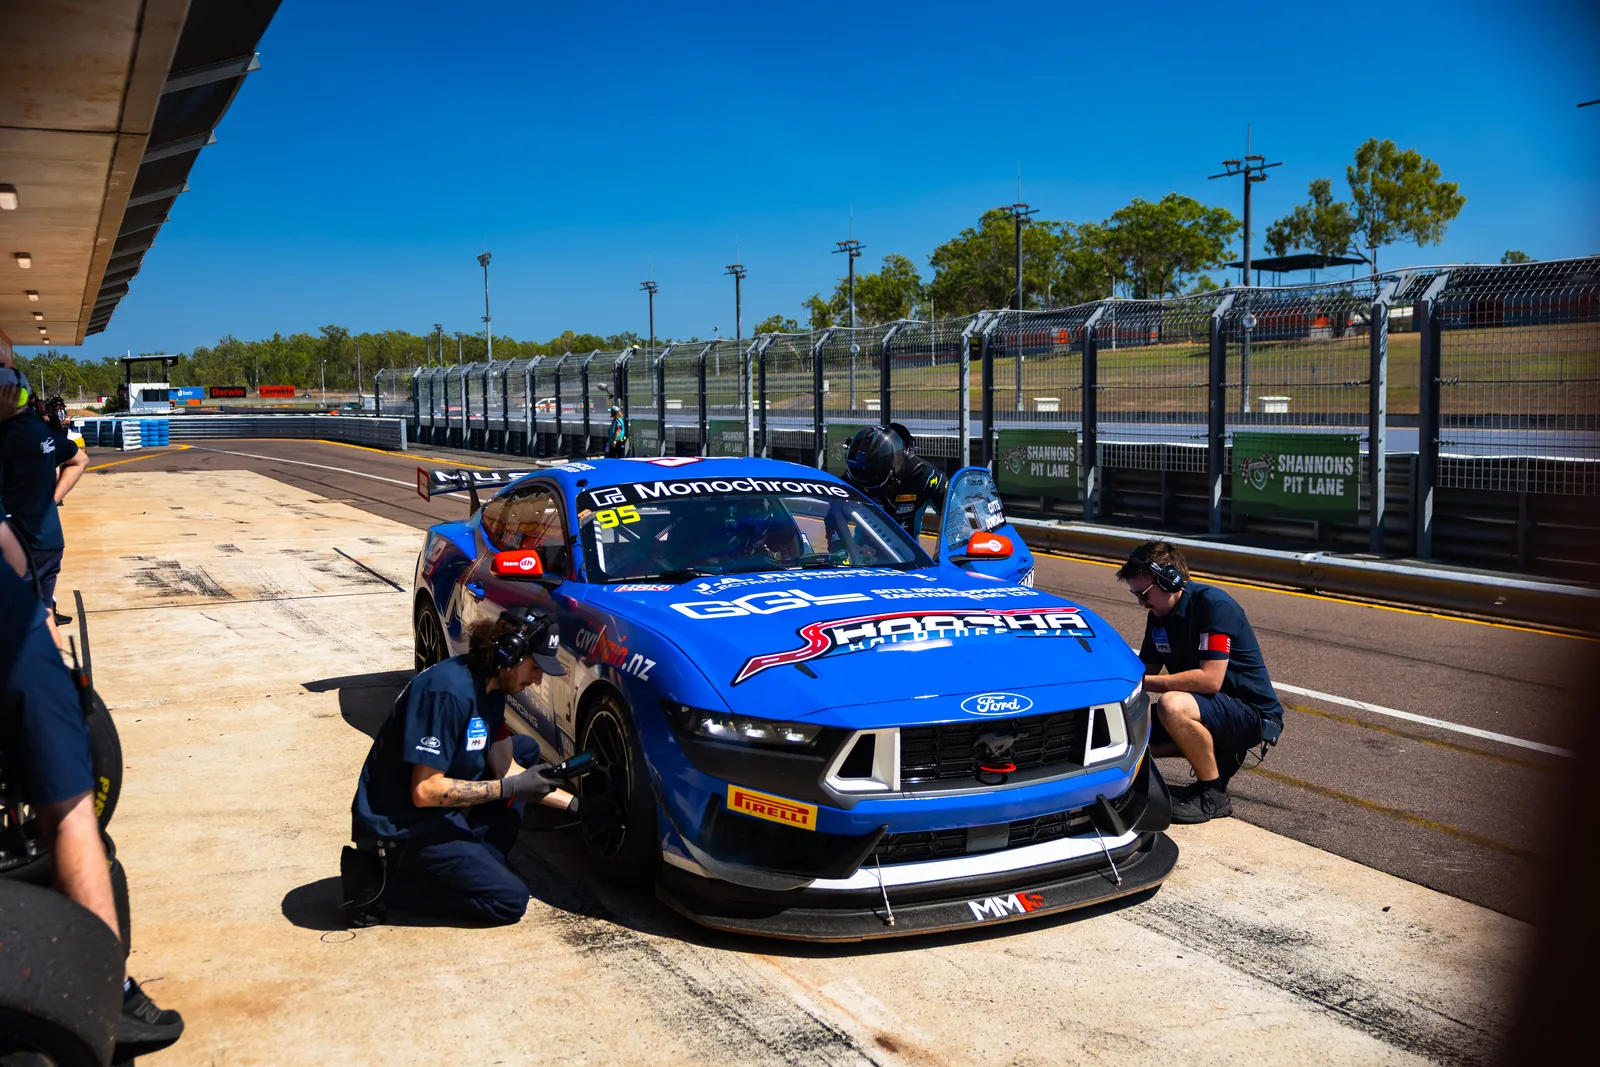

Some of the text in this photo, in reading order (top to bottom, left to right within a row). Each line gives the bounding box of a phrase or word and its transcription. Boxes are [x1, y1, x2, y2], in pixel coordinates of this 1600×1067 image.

[212, 388, 244, 397] Darwin
[1027, 445, 1075, 462] SHANNONS
[1030, 462, 1070, 478] PIT LANE
[1278, 454, 1354, 476] SHANNONS
[633, 477, 850, 499] Monochrome
[1283, 476, 1345, 496] PIT LANE
[595, 504, 641, 529] 95
[521, 558, 534, 567] dh
[670, 589, 873, 619] GGL
[977, 695, 1020, 712] Ford
[734, 790, 810, 825] PIRELLI
